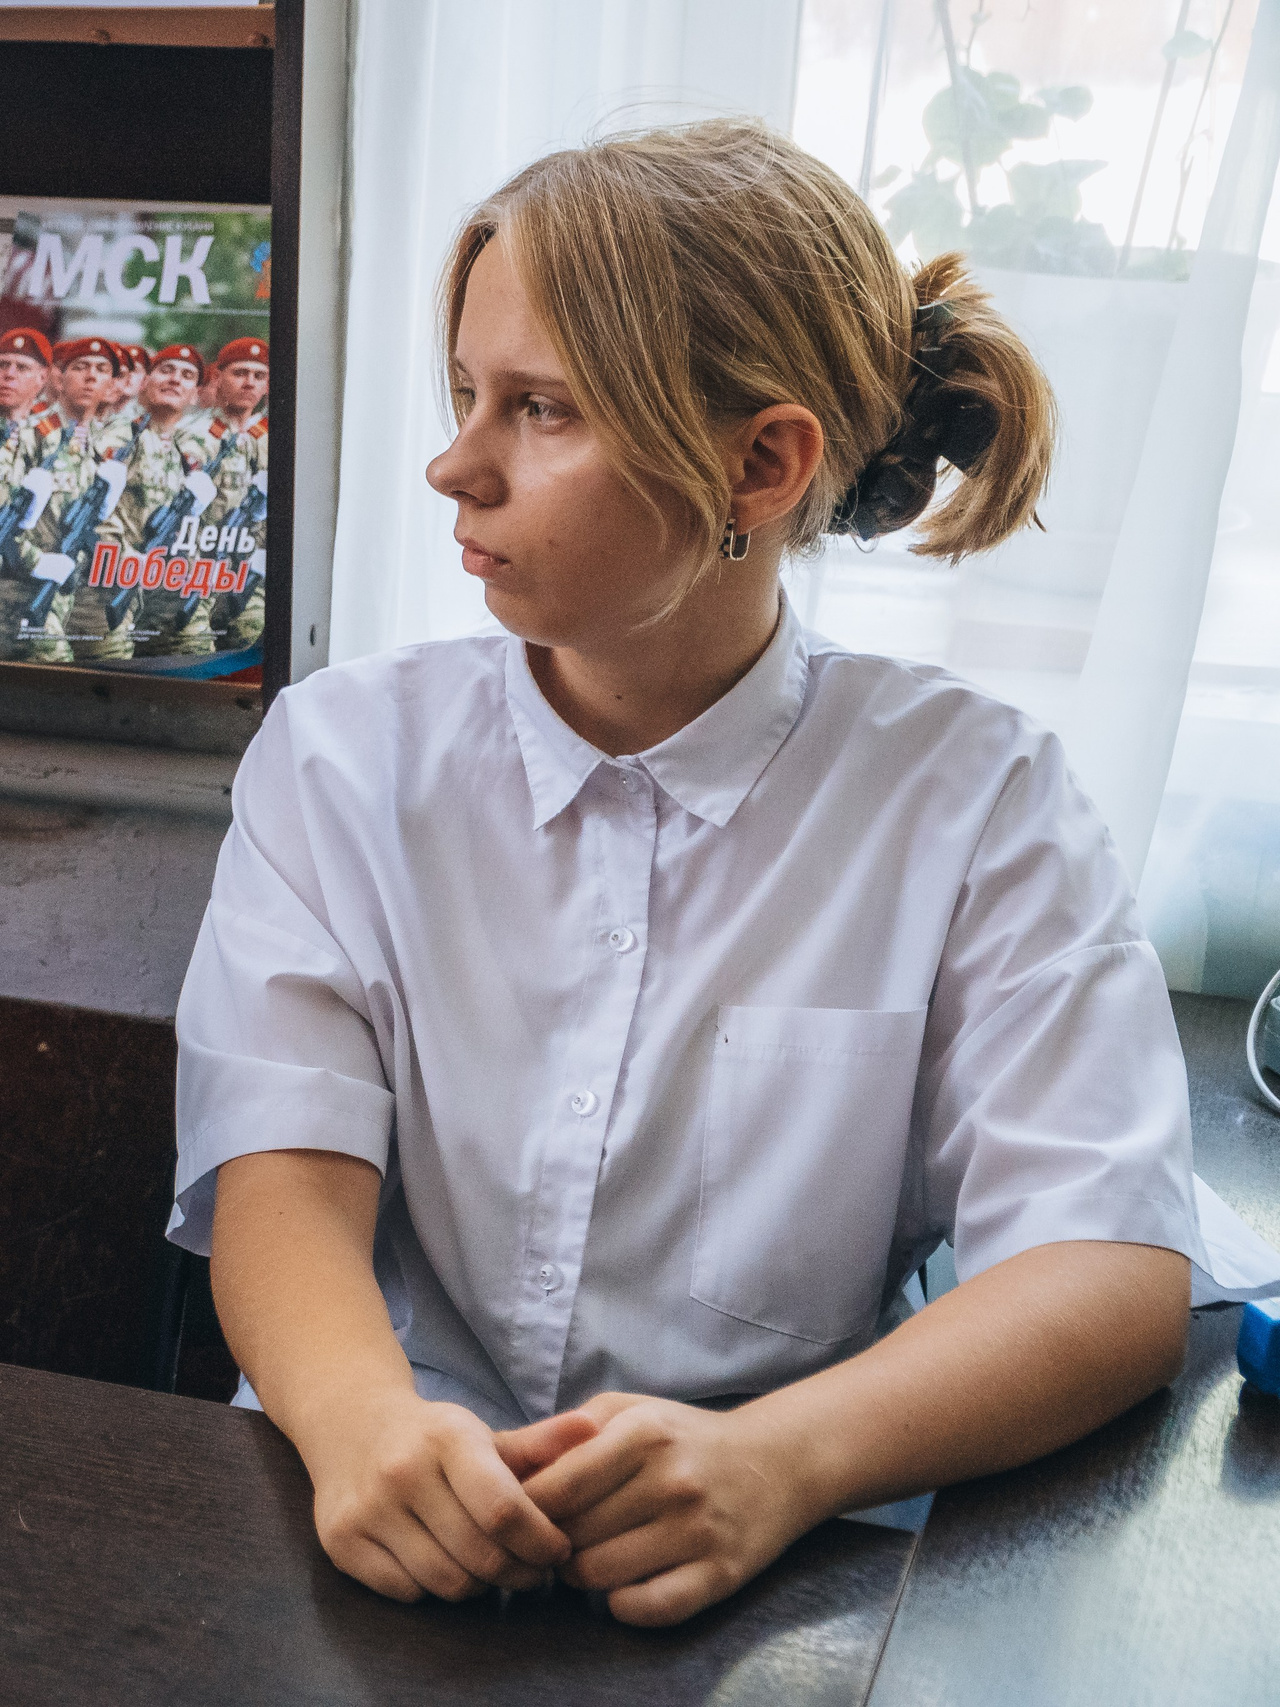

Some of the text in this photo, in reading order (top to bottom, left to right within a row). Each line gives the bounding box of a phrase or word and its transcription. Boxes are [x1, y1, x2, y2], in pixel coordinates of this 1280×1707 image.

[28, 233, 215, 306] МСК
[170, 514, 257, 556] День
[88, 541, 251, 599] Победы
